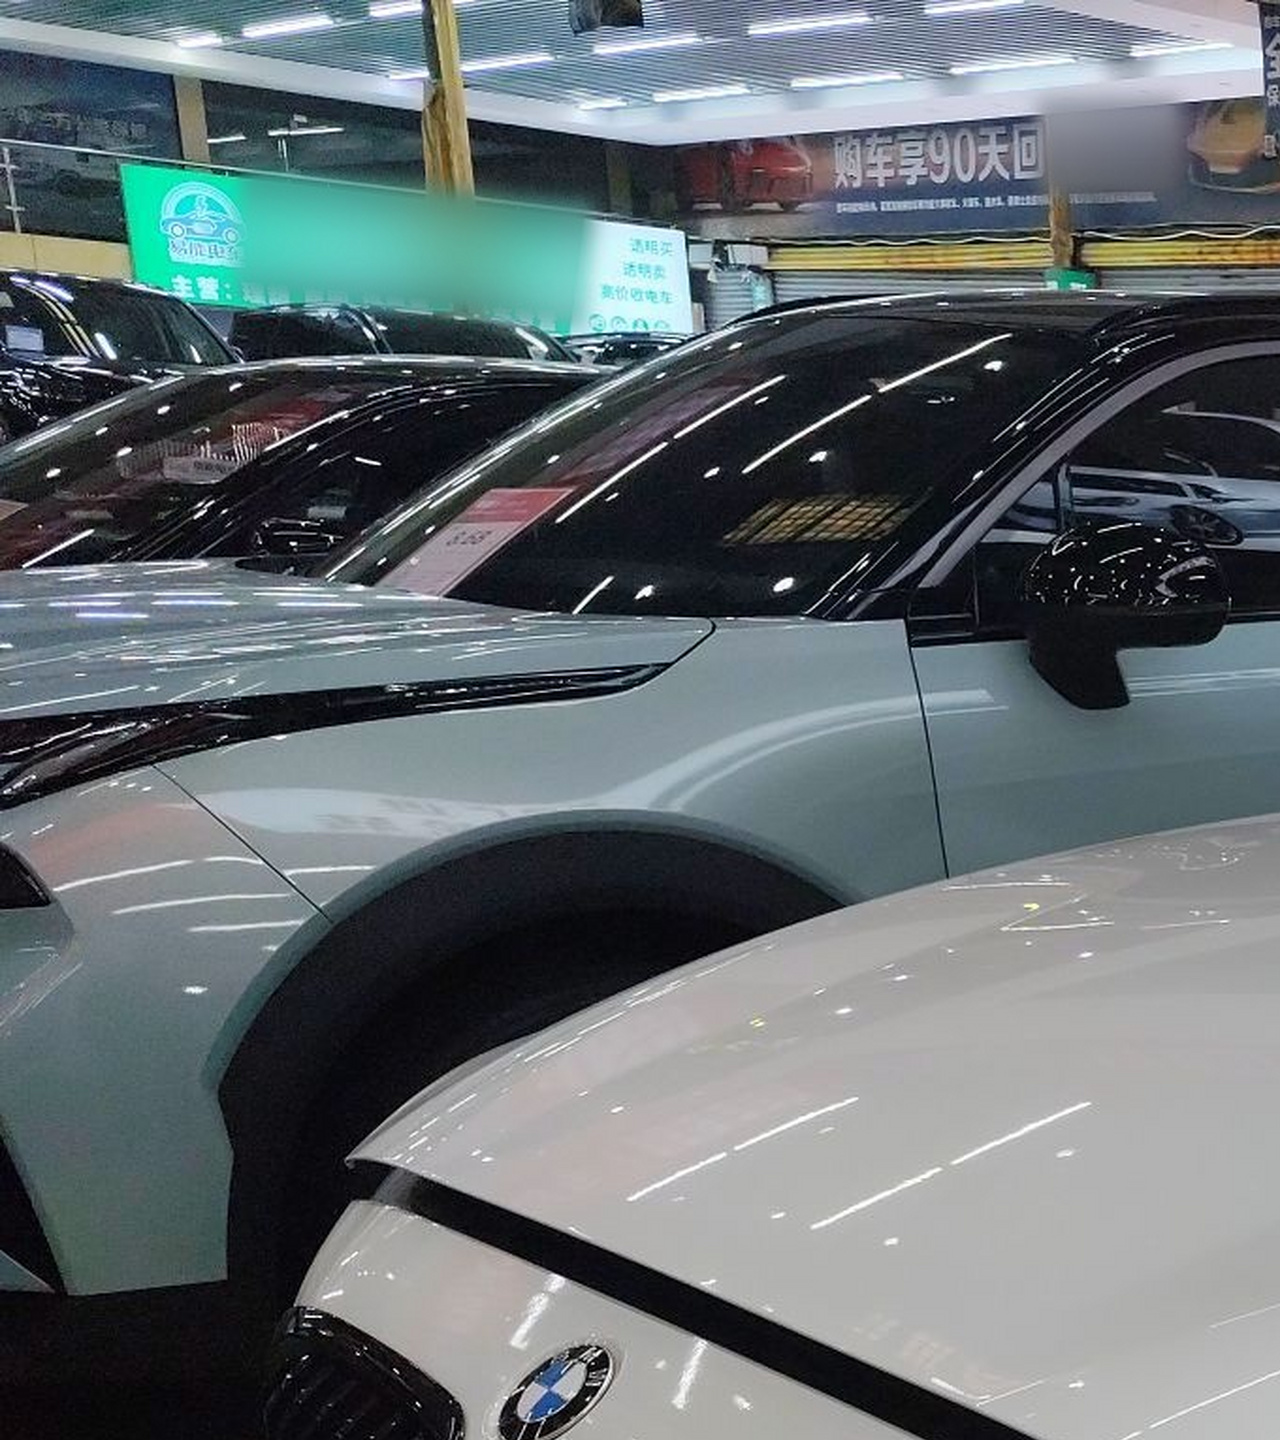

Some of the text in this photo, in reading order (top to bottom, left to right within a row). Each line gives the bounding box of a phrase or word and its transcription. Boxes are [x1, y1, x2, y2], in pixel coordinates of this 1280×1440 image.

[834, 120, 1045, 190] 购车享90天回
